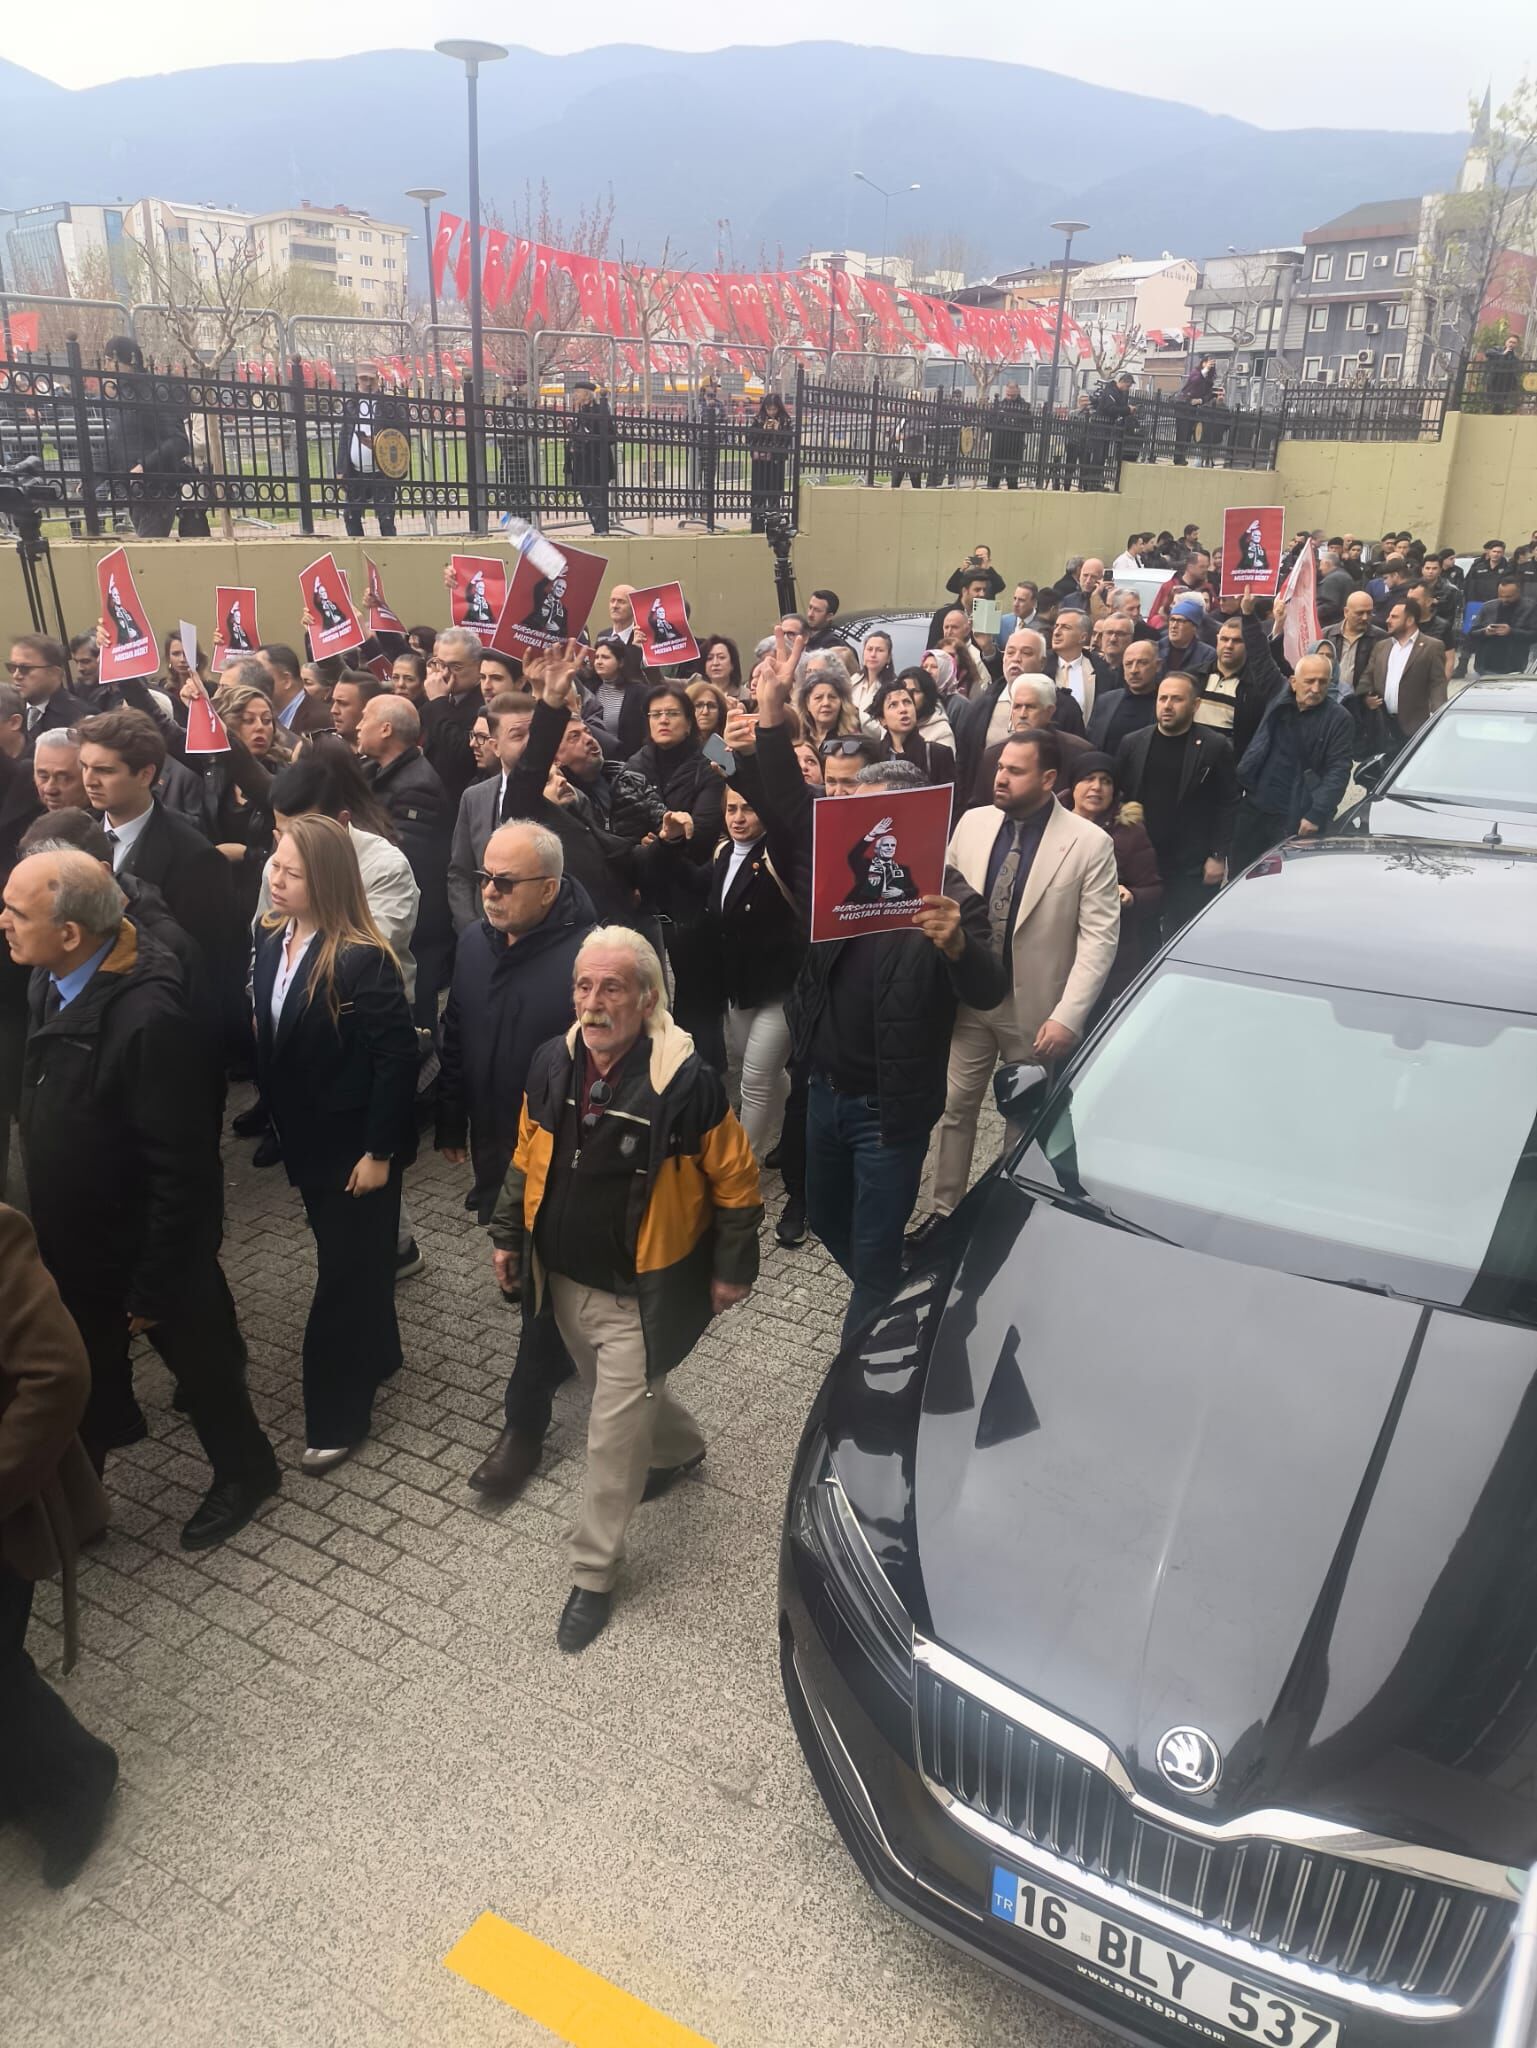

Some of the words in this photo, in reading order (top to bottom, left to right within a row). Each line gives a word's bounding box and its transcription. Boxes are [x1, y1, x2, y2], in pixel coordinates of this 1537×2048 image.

[839, 909, 881, 921] MUSTAFA
[994, 1892, 1014, 1913] TR
[1021, 1885, 1068, 1940] 16
[1098, 1920, 1196, 2001] BLY
[1228, 1981, 1332, 2048] 537
